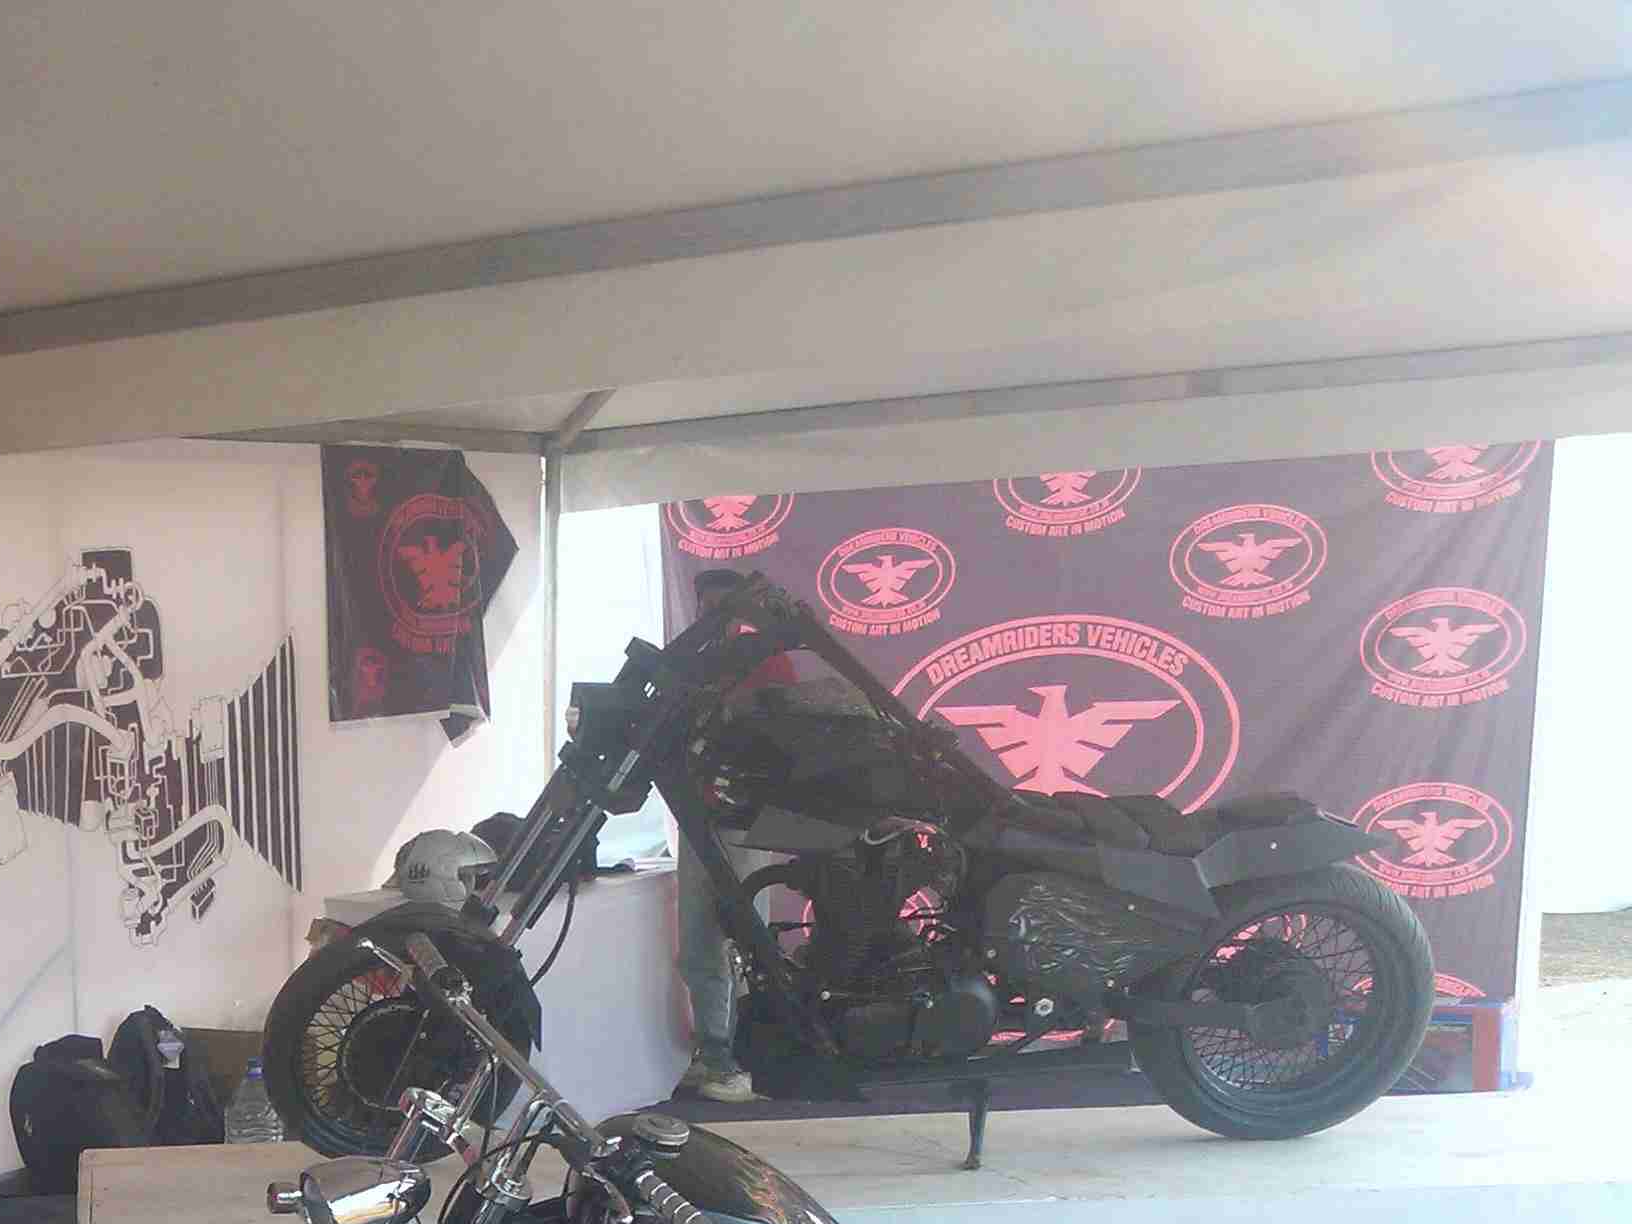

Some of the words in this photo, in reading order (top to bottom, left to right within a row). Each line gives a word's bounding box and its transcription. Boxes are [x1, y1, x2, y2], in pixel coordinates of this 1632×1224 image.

[1048, 526, 1068, 537] ART
[1071, 525, 1082, 535] IN
[1084, 507, 1126, 532] MOTION
[829, 613, 866, 634] CUSTOM
[868, 625, 888, 636] ART
[890, 624, 901, 635] IN
[903, 608, 941, 632] MOTION
[926, 623, 1081, 687] DREAMRIDERS
[1087, 624, 1189, 677] VEHICLES
